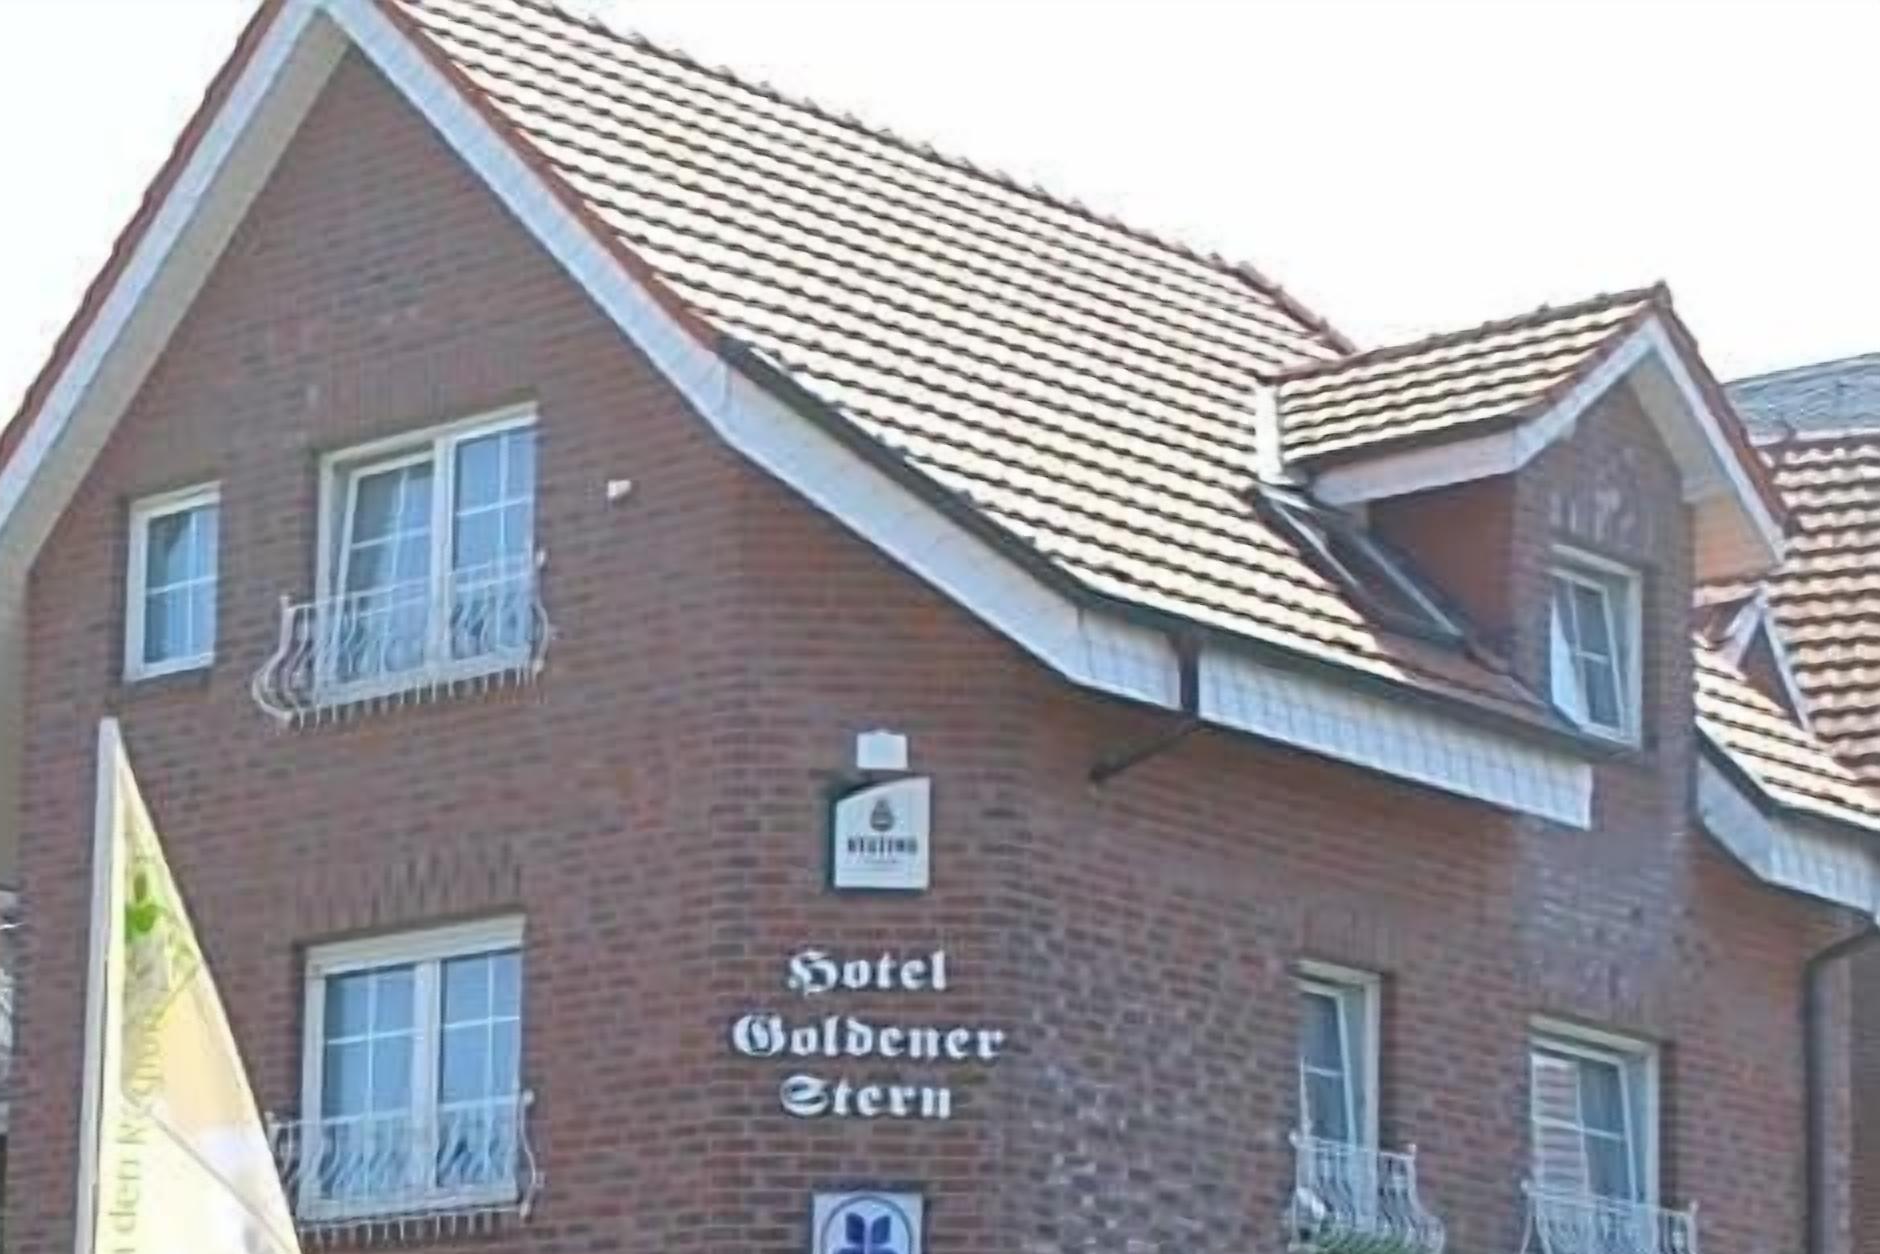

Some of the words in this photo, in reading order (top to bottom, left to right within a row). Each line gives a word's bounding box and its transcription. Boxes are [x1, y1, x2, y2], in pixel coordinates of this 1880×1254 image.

[788, 949, 947, 998] Hotel
[732, 1013, 1005, 1060] Goldener
[779, 1074, 951, 1119] Stern
